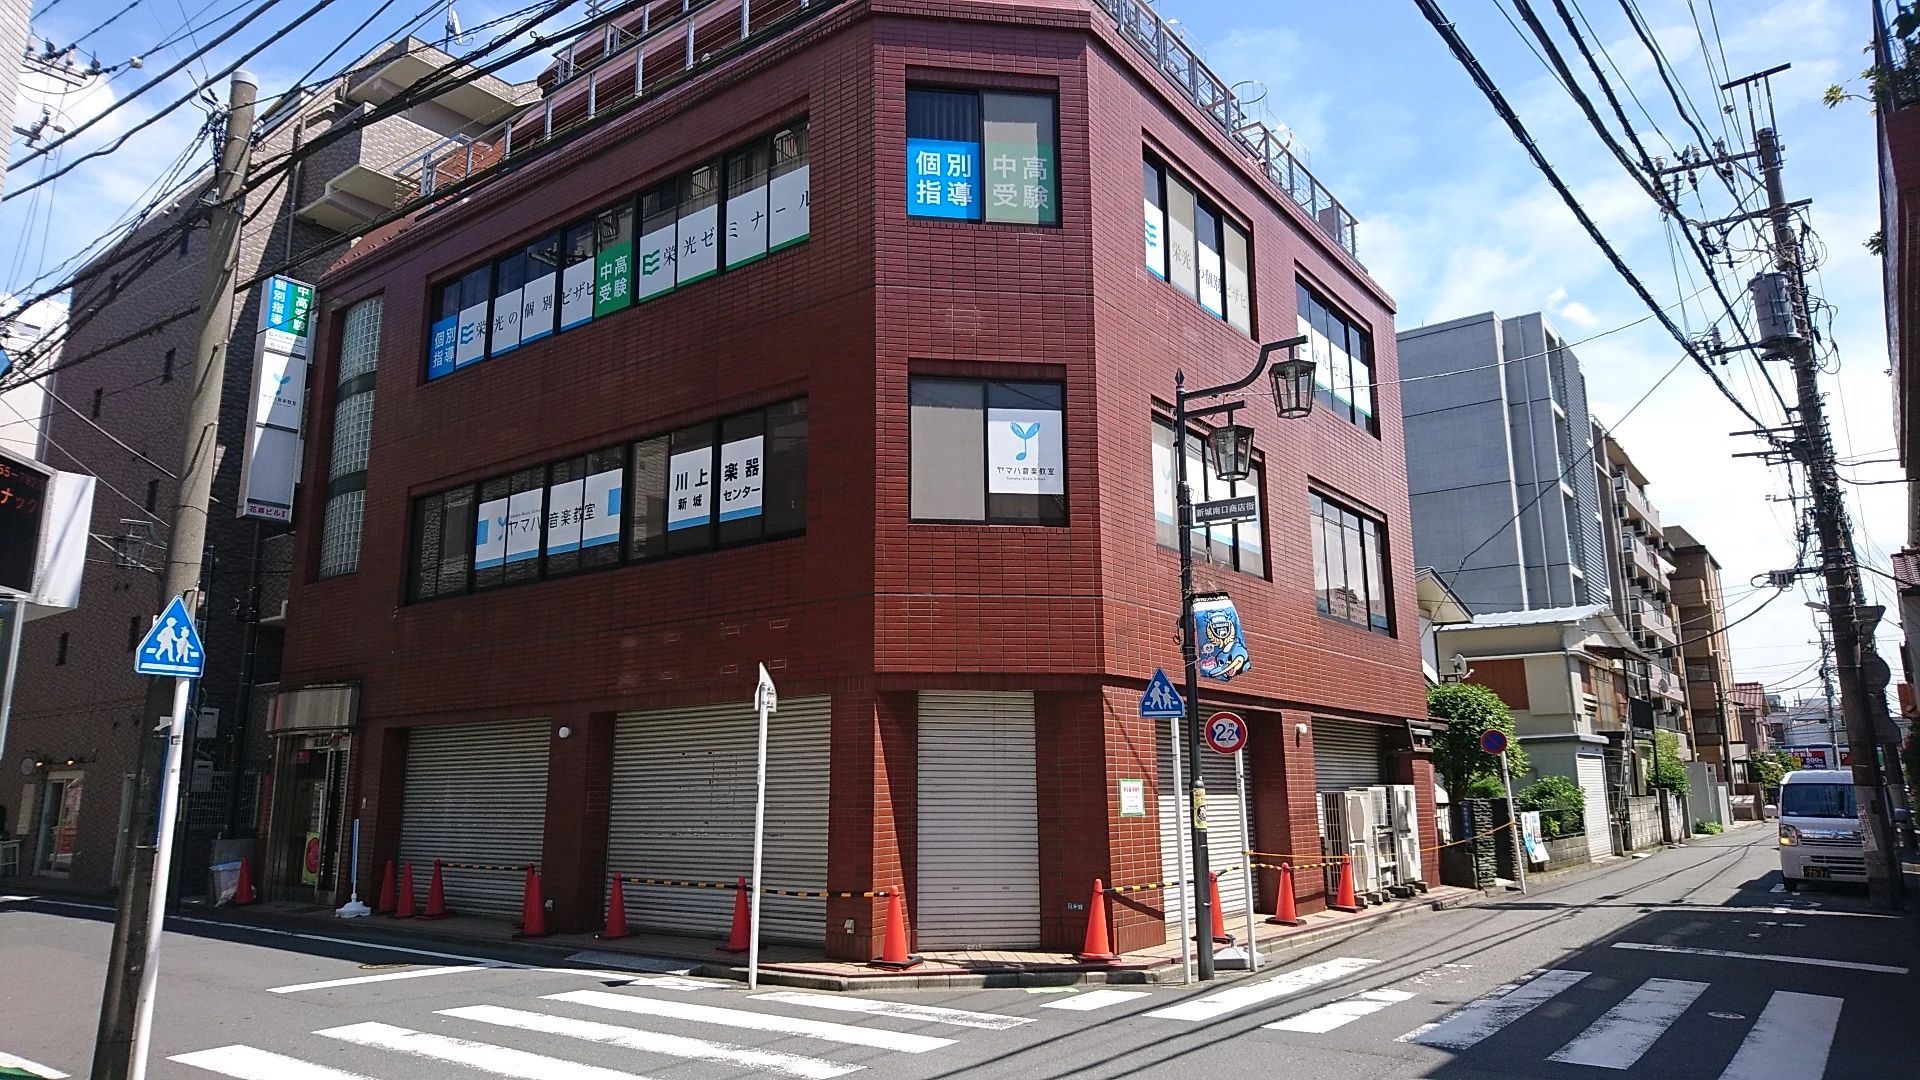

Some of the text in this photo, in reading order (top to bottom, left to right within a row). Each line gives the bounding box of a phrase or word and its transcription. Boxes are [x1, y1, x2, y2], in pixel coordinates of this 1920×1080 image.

[916, 151, 972, 178] 個別
[993, 154, 1047, 180] 中高
[916, 179, 972, 207] 指導
[993, 183, 1049, 209] 受験
[663, 190, 810, 267] 栄光ゼミナール
[600, 254, 628, 281] 中高
[270, 280, 287, 326] 個別指導
[599, 278, 627, 305] 受験
[293, 286, 310, 332] 中高受験
[434, 325, 456, 350] 個別
[433, 346, 455, 368] 指導
[997, 466, 1055, 476] ヤマハ音楽教室
[508, 503, 596, 536] ヤマハ音楽教室
[1196, 501, 1255, 517] 新城南口商店街
